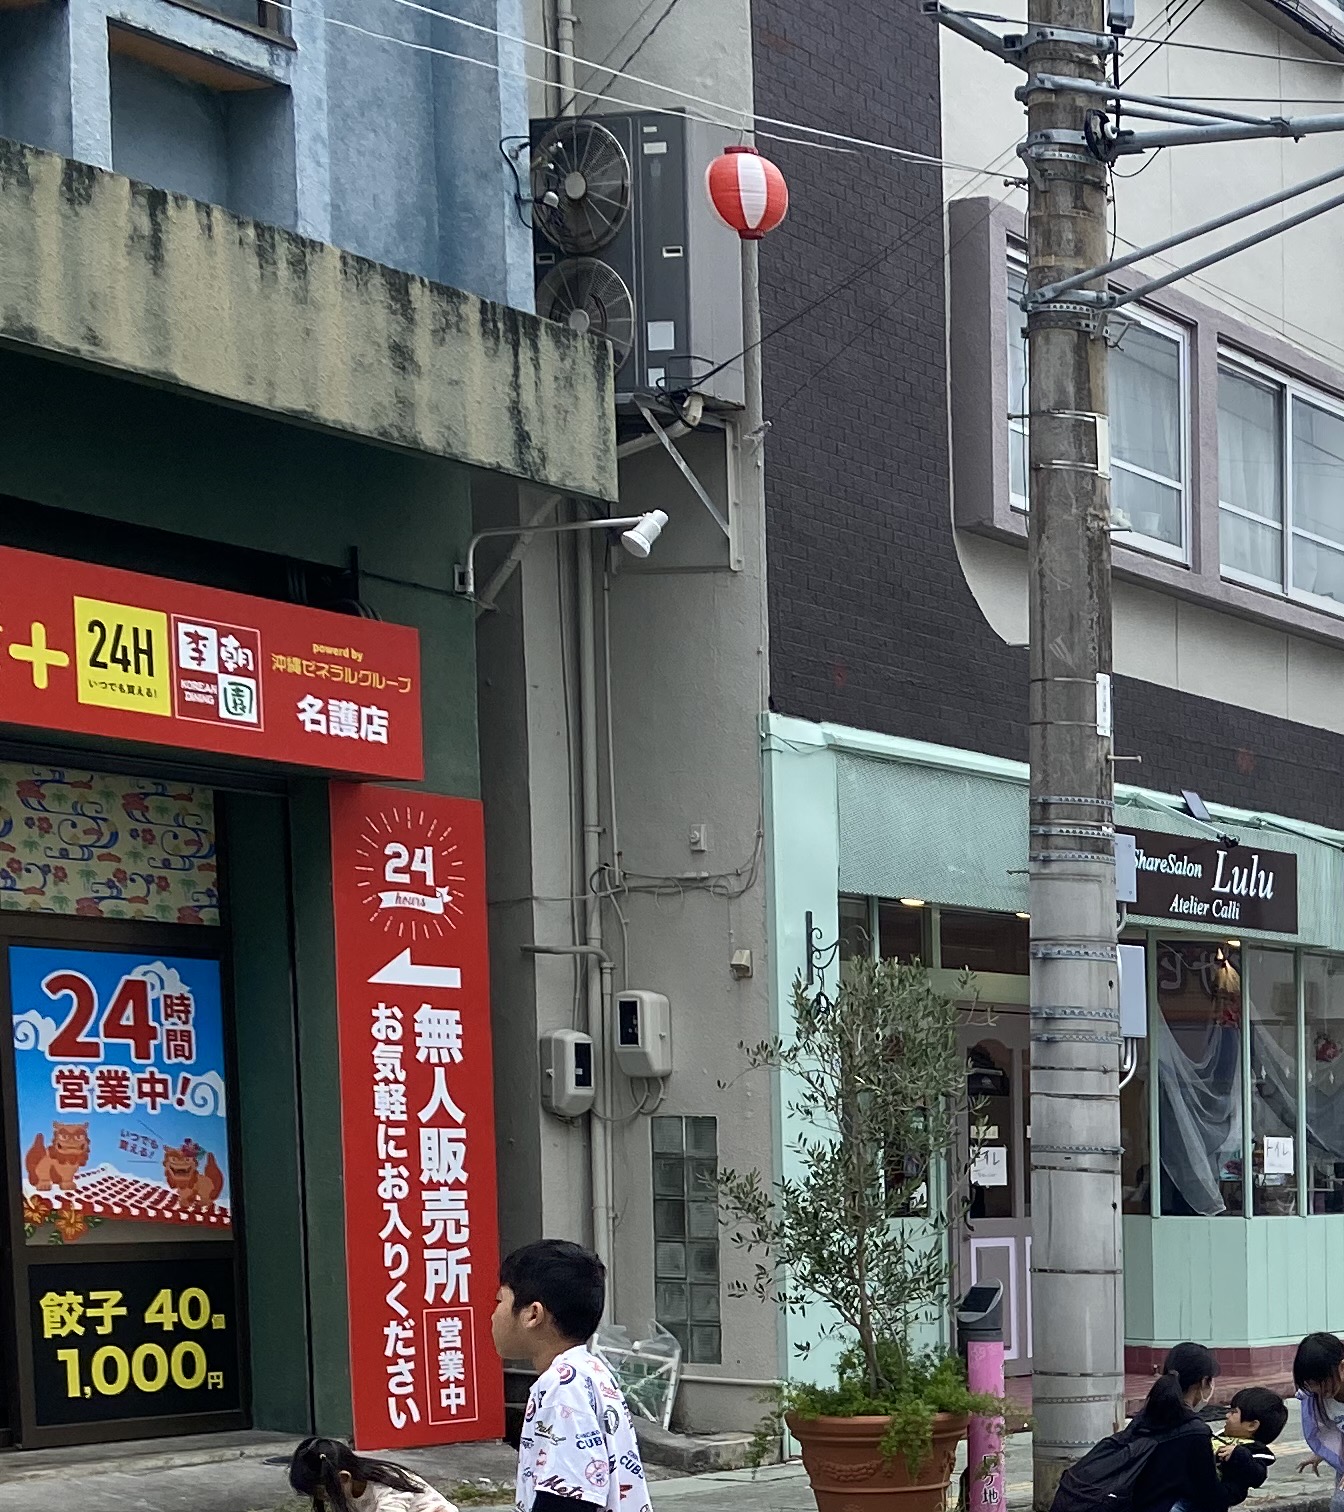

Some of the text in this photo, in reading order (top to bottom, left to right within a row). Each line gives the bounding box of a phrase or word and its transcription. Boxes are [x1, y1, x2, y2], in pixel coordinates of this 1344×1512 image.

[88, 619, 154, 677] 24H
[296, 693, 389, 744] 名護店
[383, 842, 434, 886] 24
[1211, 850, 1275, 900] Lulu
[395, 892, 426, 907] hours
[1169, 893, 1241, 920] Atelier Calli
[55, 1068, 191, 1111] 営業中!
[412, 1003, 471, 1305] 無人販売所
[371, 1002, 421, 1430] お気軽にお入りください
[39, 1290, 128, 1339] 餃子
[57, 1340, 224, 1399] 1,000円
[436, 1316, 466, 1415] 営業中
[576, 1437, 603, 1450] CUB
